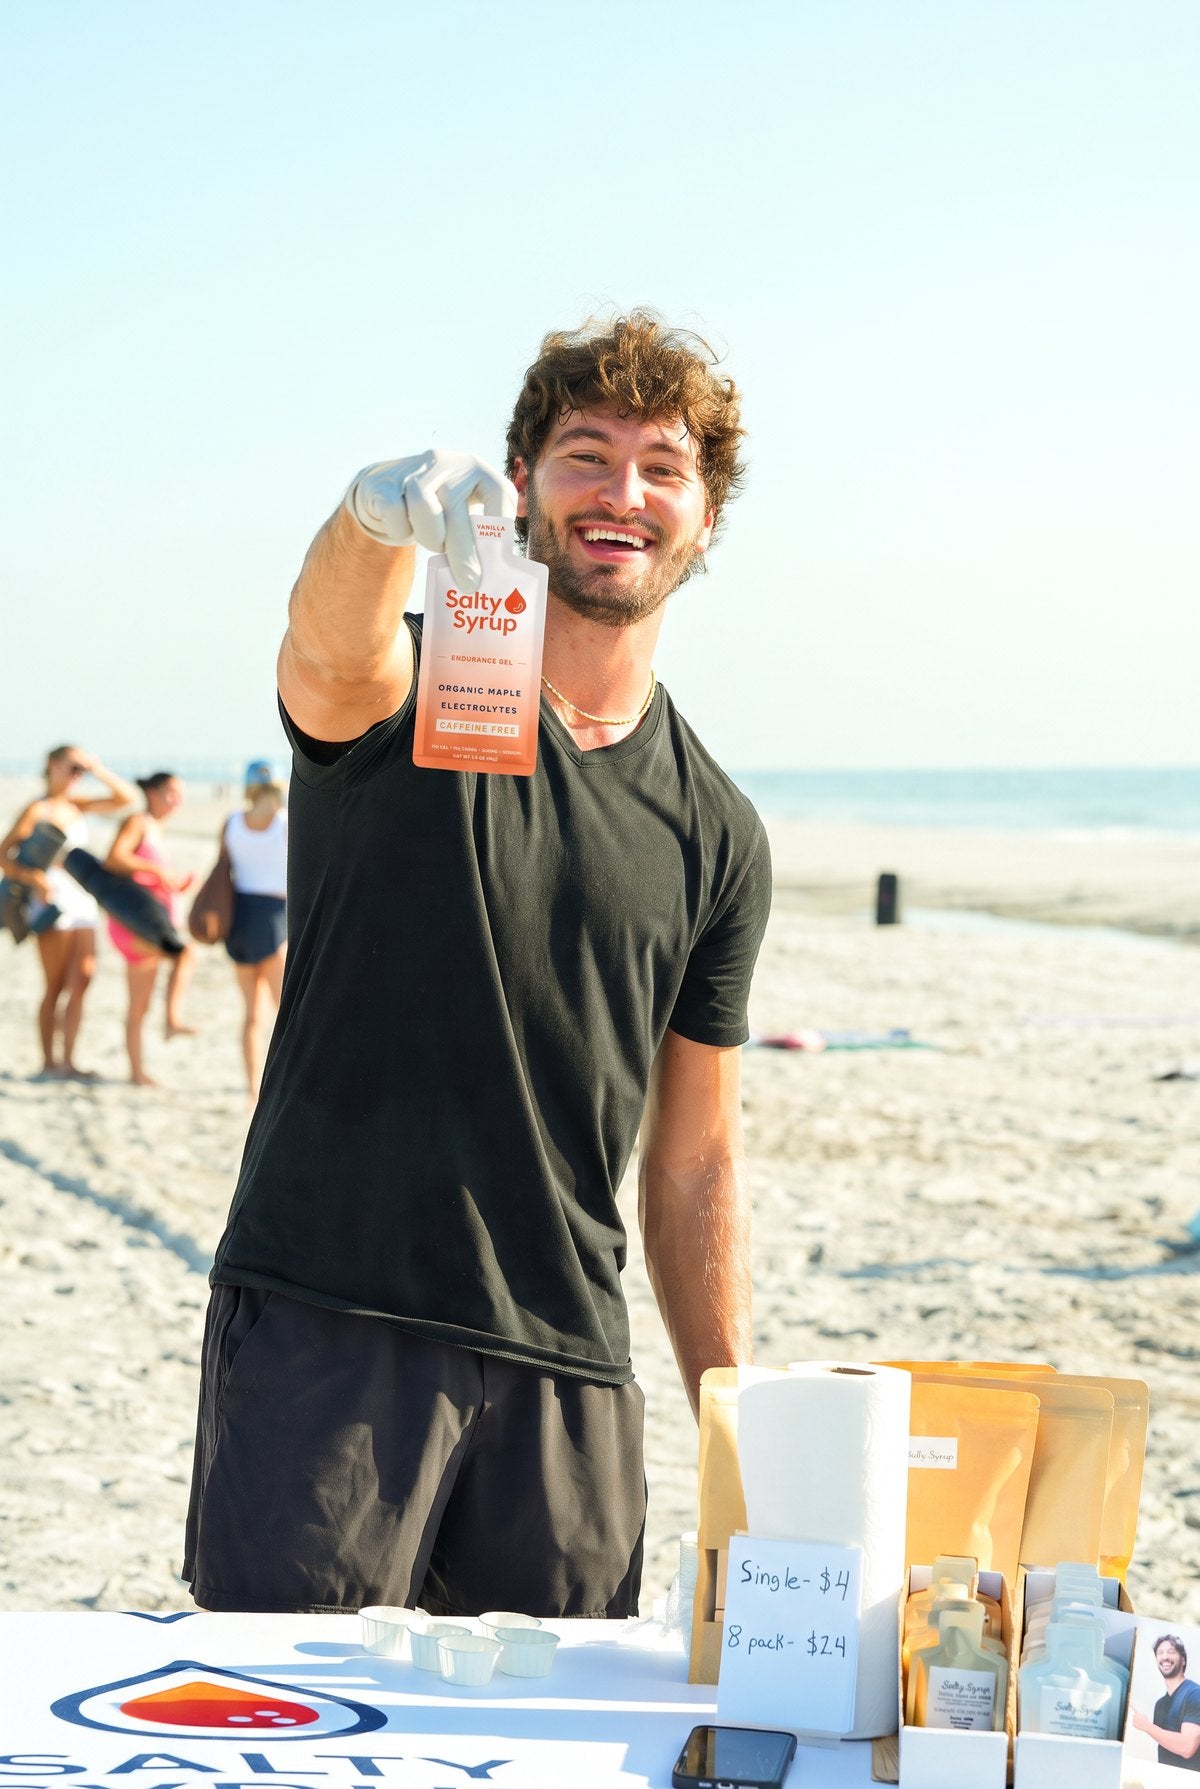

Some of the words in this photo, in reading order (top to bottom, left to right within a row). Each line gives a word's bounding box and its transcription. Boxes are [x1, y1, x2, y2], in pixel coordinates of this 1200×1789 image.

[476, 524, 506, 532] VANILLA
[445, 589, 503, 616] Salty
[453, 610, 518, 637] Syrup
[451, 655, 497, 665] ENDURANCE
[438, 684, 484, 695] ORGANIC
[487, 688, 522, 697] MAPLE
[441, 702, 518, 714] ELECTROLYTES
[439, 721, 488, 733] CAFFEINE
[491, 726, 516, 735] FREE
[928, 1451, 954, 1463] Syrup
[741, 1560, 810, 1592] Single-
[819, 1566, 850, 1600] $4
[728, 1625, 742, 1647] 8
[749, 1633, 794, 1655] pack-
[807, 1630, 846, 1658] $24
[0, 1753, 514, 1780] SALTY
